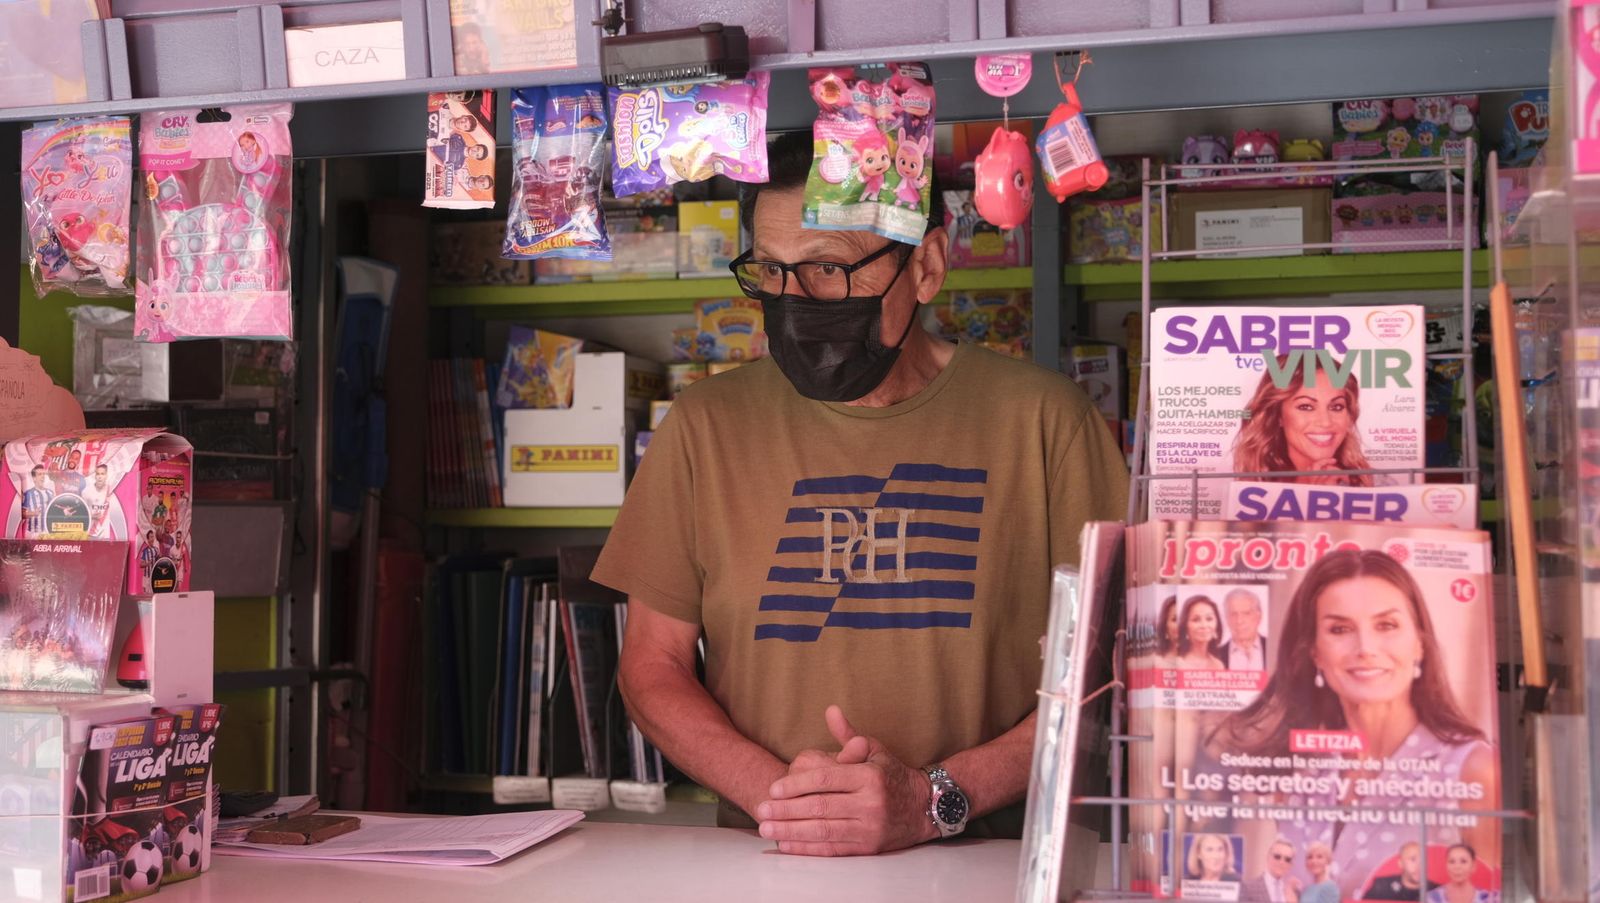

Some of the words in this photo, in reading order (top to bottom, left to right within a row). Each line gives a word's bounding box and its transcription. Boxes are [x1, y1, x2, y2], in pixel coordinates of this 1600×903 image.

[314, 47, 380, 68] CAZA
[161, 115, 190, 130] CRY
[1163, 315, 1351, 354] SABER
[1235, 355, 1264, 371] tve
[1260, 348, 1413, 389] VIVIR
[1157, 386, 1181, 396] LOS
[1183, 386, 1242, 396] MEJORES
[1157, 398, 1208, 407] TRUCOS
[1157, 409, 1253, 419] QUITA-HAMBRE
[541, 448, 615, 462] PANINI
[1154, 506, 1170, 514] TUS
[1235, 486, 1409, 521] SABER
[33, 544, 52, 553] ABBA
[53, 544, 83, 553] ARRIVAL
[1454, 582, 1472, 600] 1€
[1183, 691, 1195, 699] SU
[1295, 734, 1363, 750] LETIZIA
[110, 747, 154, 761] CALENDARIO
[172, 735, 215, 767] LIGA
[114, 748, 173, 784] LIGA
[1220, 752, 1272, 767] Seduce
[1273, 756, 1291, 768] en
[1292, 754, 1307, 768] la
[1307, 754, 1362, 770] cumbre
[1362, 757, 1382, 771] de
[1383, 757, 1398, 771] la
[1399, 757, 1441, 772] OTAN
[1182, 768, 1224, 791] Los
[1227, 773, 1331, 795] secretos
[1334, 777, 1351, 800] y
[1353, 772, 1485, 799] anécdotas
